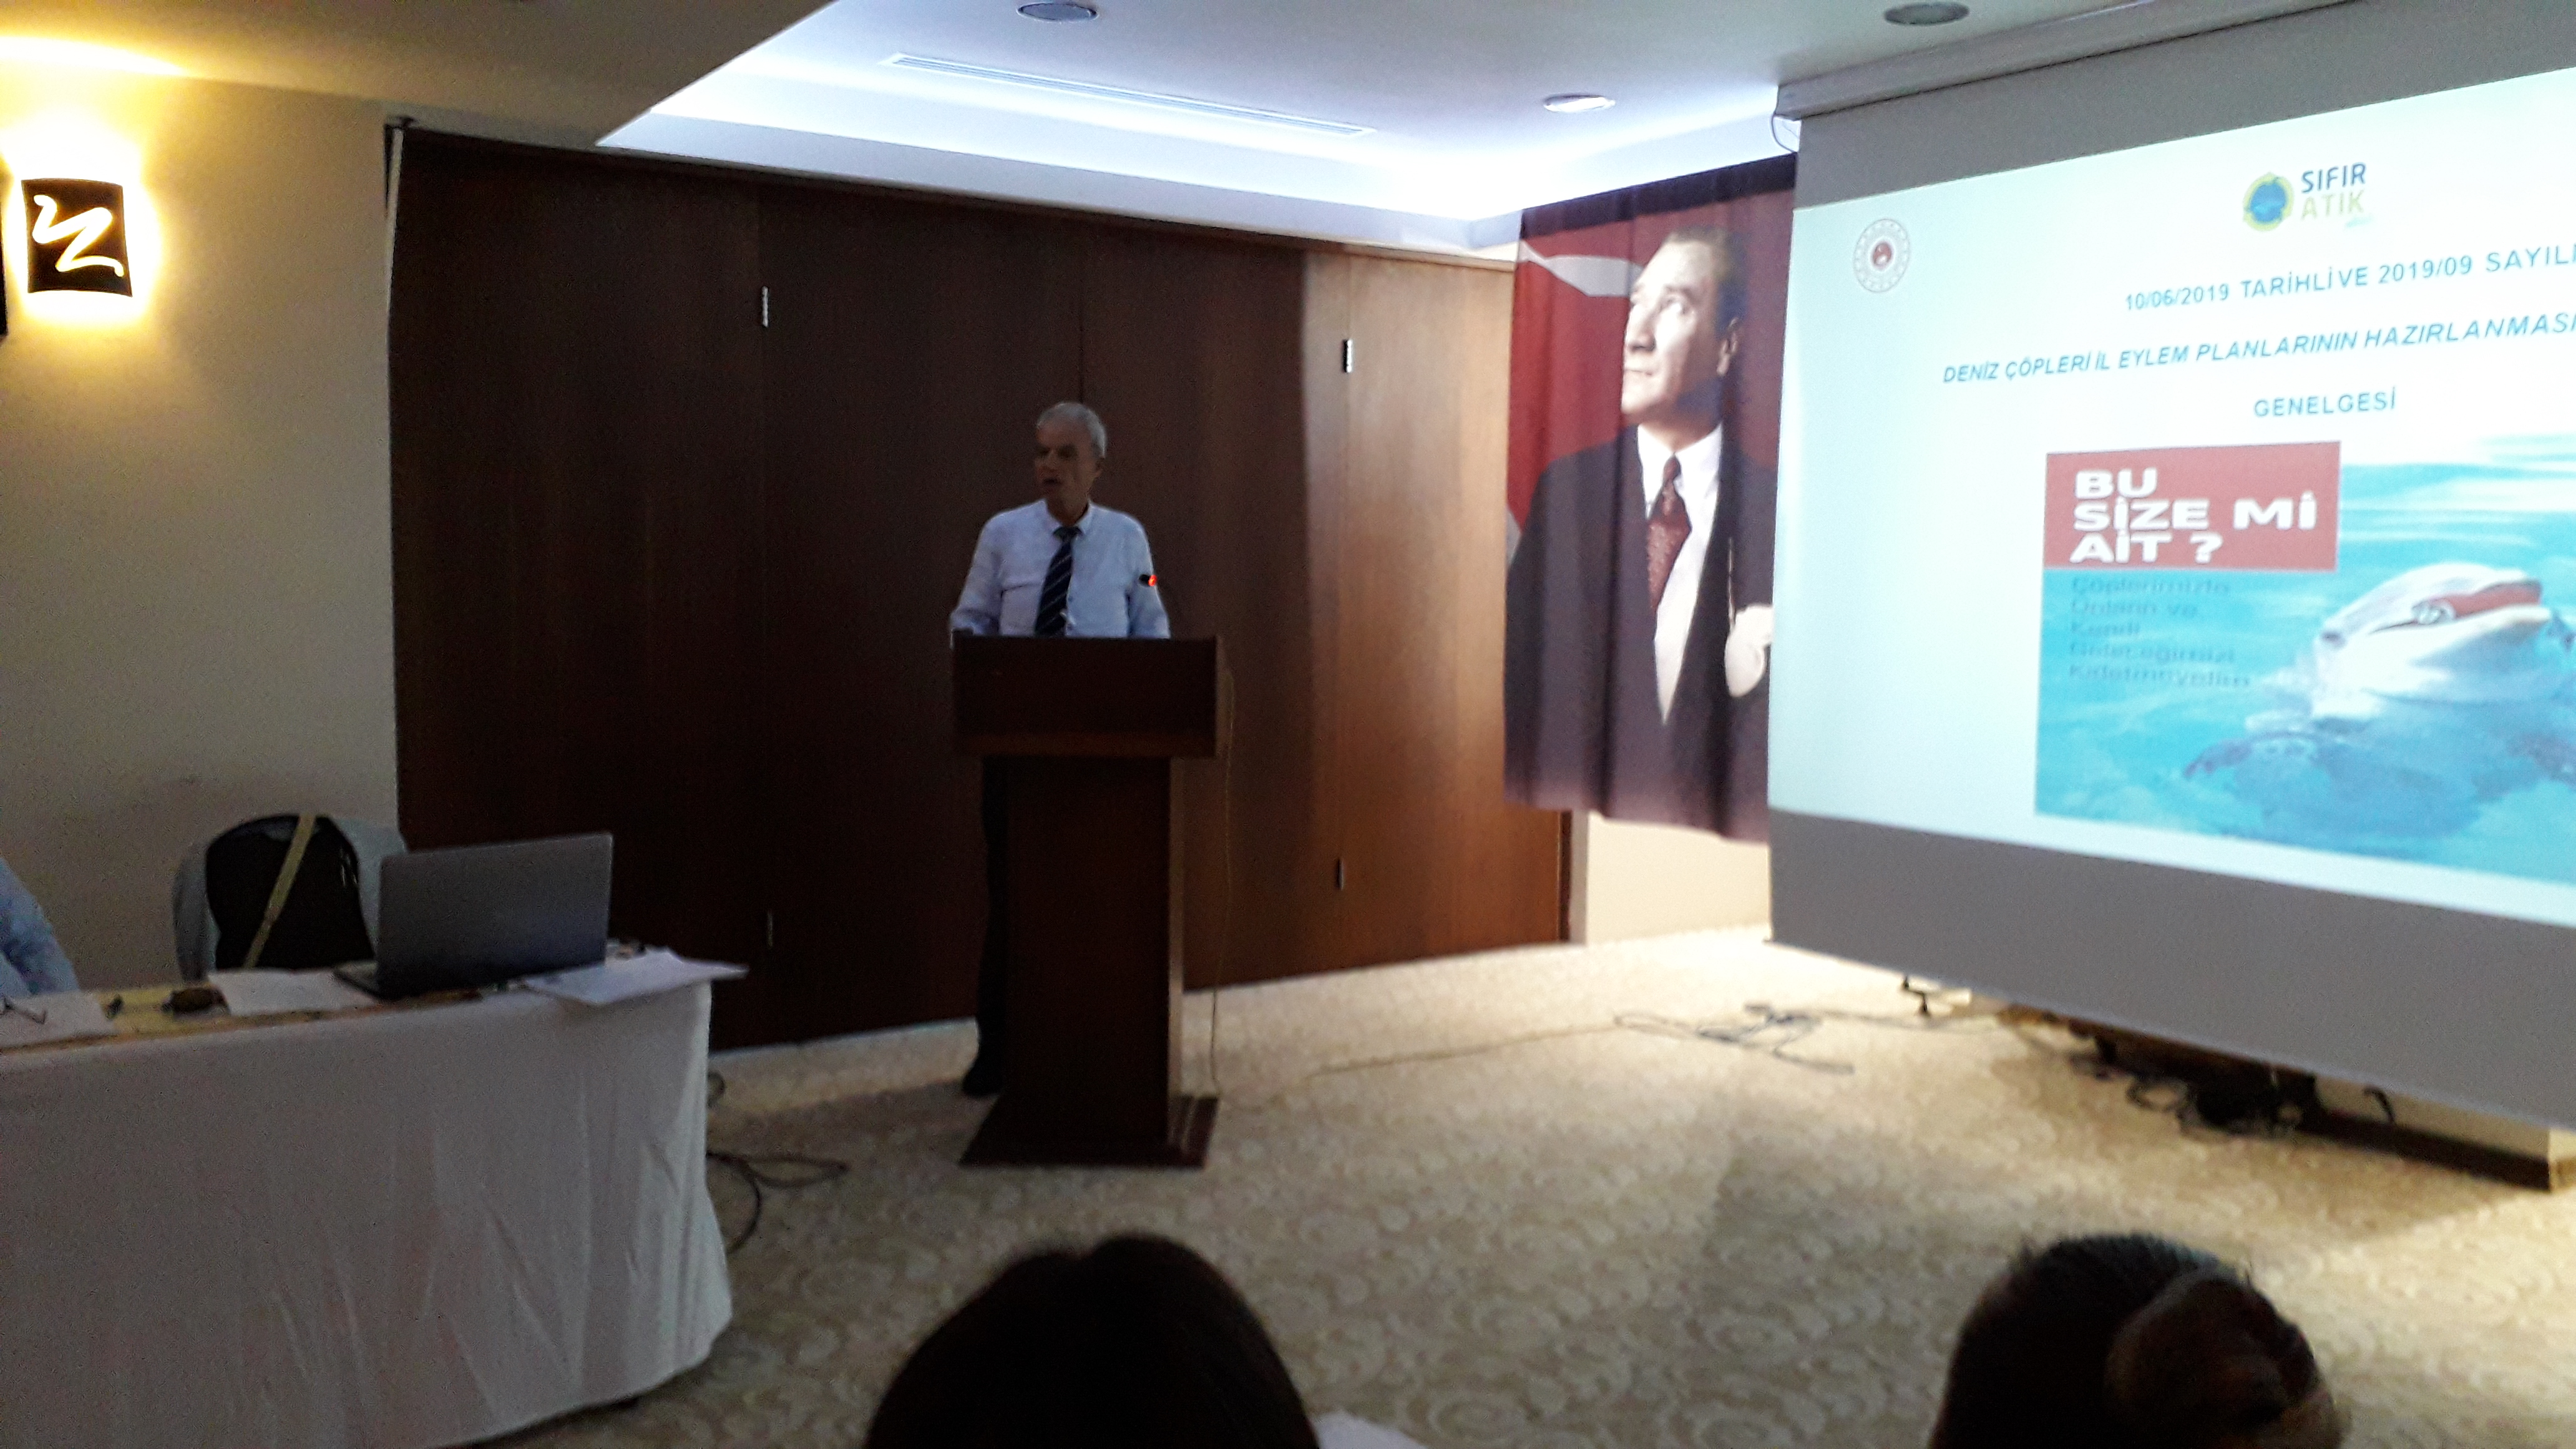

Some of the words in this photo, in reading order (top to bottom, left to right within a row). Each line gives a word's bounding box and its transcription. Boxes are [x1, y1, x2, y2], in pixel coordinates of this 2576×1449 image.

[2301, 190, 2365, 220] ATIK
[2125, 283, 2229, 311] 10/06/2019
[2338, 266, 2369, 288] VE
[2378, 254, 2473, 285] 2019/09
[1943, 359, 1999, 383] DENİZ
[2004, 349, 2092, 381] ÇÖPLERİ
[2119, 344, 2190, 369] EYLEM
[2195, 330, 2358, 362] PLANLARININ
[2253, 385, 2396, 417] GENELGESİ
[2075, 467, 2159, 500] BU
[2073, 496, 2211, 532] SİZE
[2233, 490, 2318, 530] Mİ
[2069, 529, 2174, 564] AİT
[2189, 531, 2224, 564] ?
